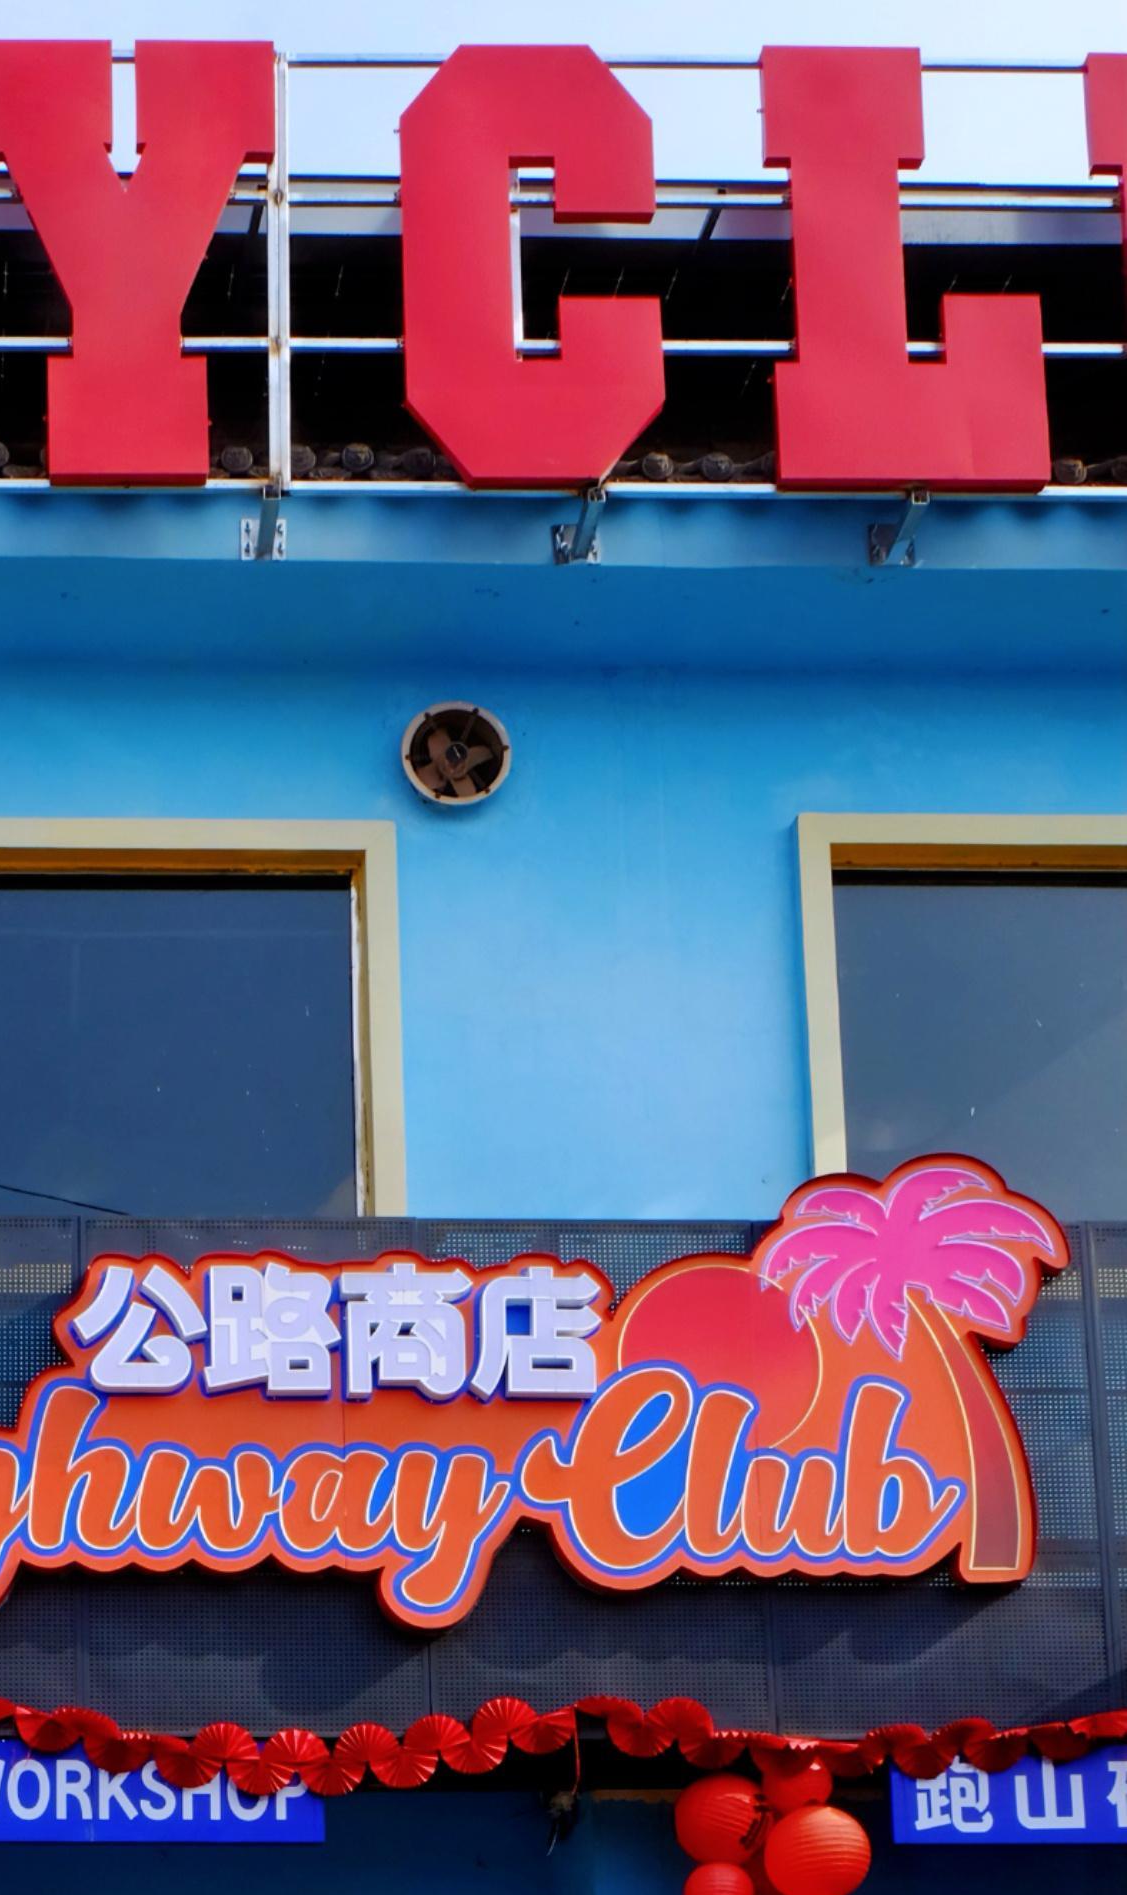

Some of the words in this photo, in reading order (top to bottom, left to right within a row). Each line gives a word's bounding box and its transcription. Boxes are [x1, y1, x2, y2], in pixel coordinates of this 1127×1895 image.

[400, 44, 1127, 493] CL
[71, 1260, 601, 1398] 公路商店
[519, 1363, 964, 1566] Club
